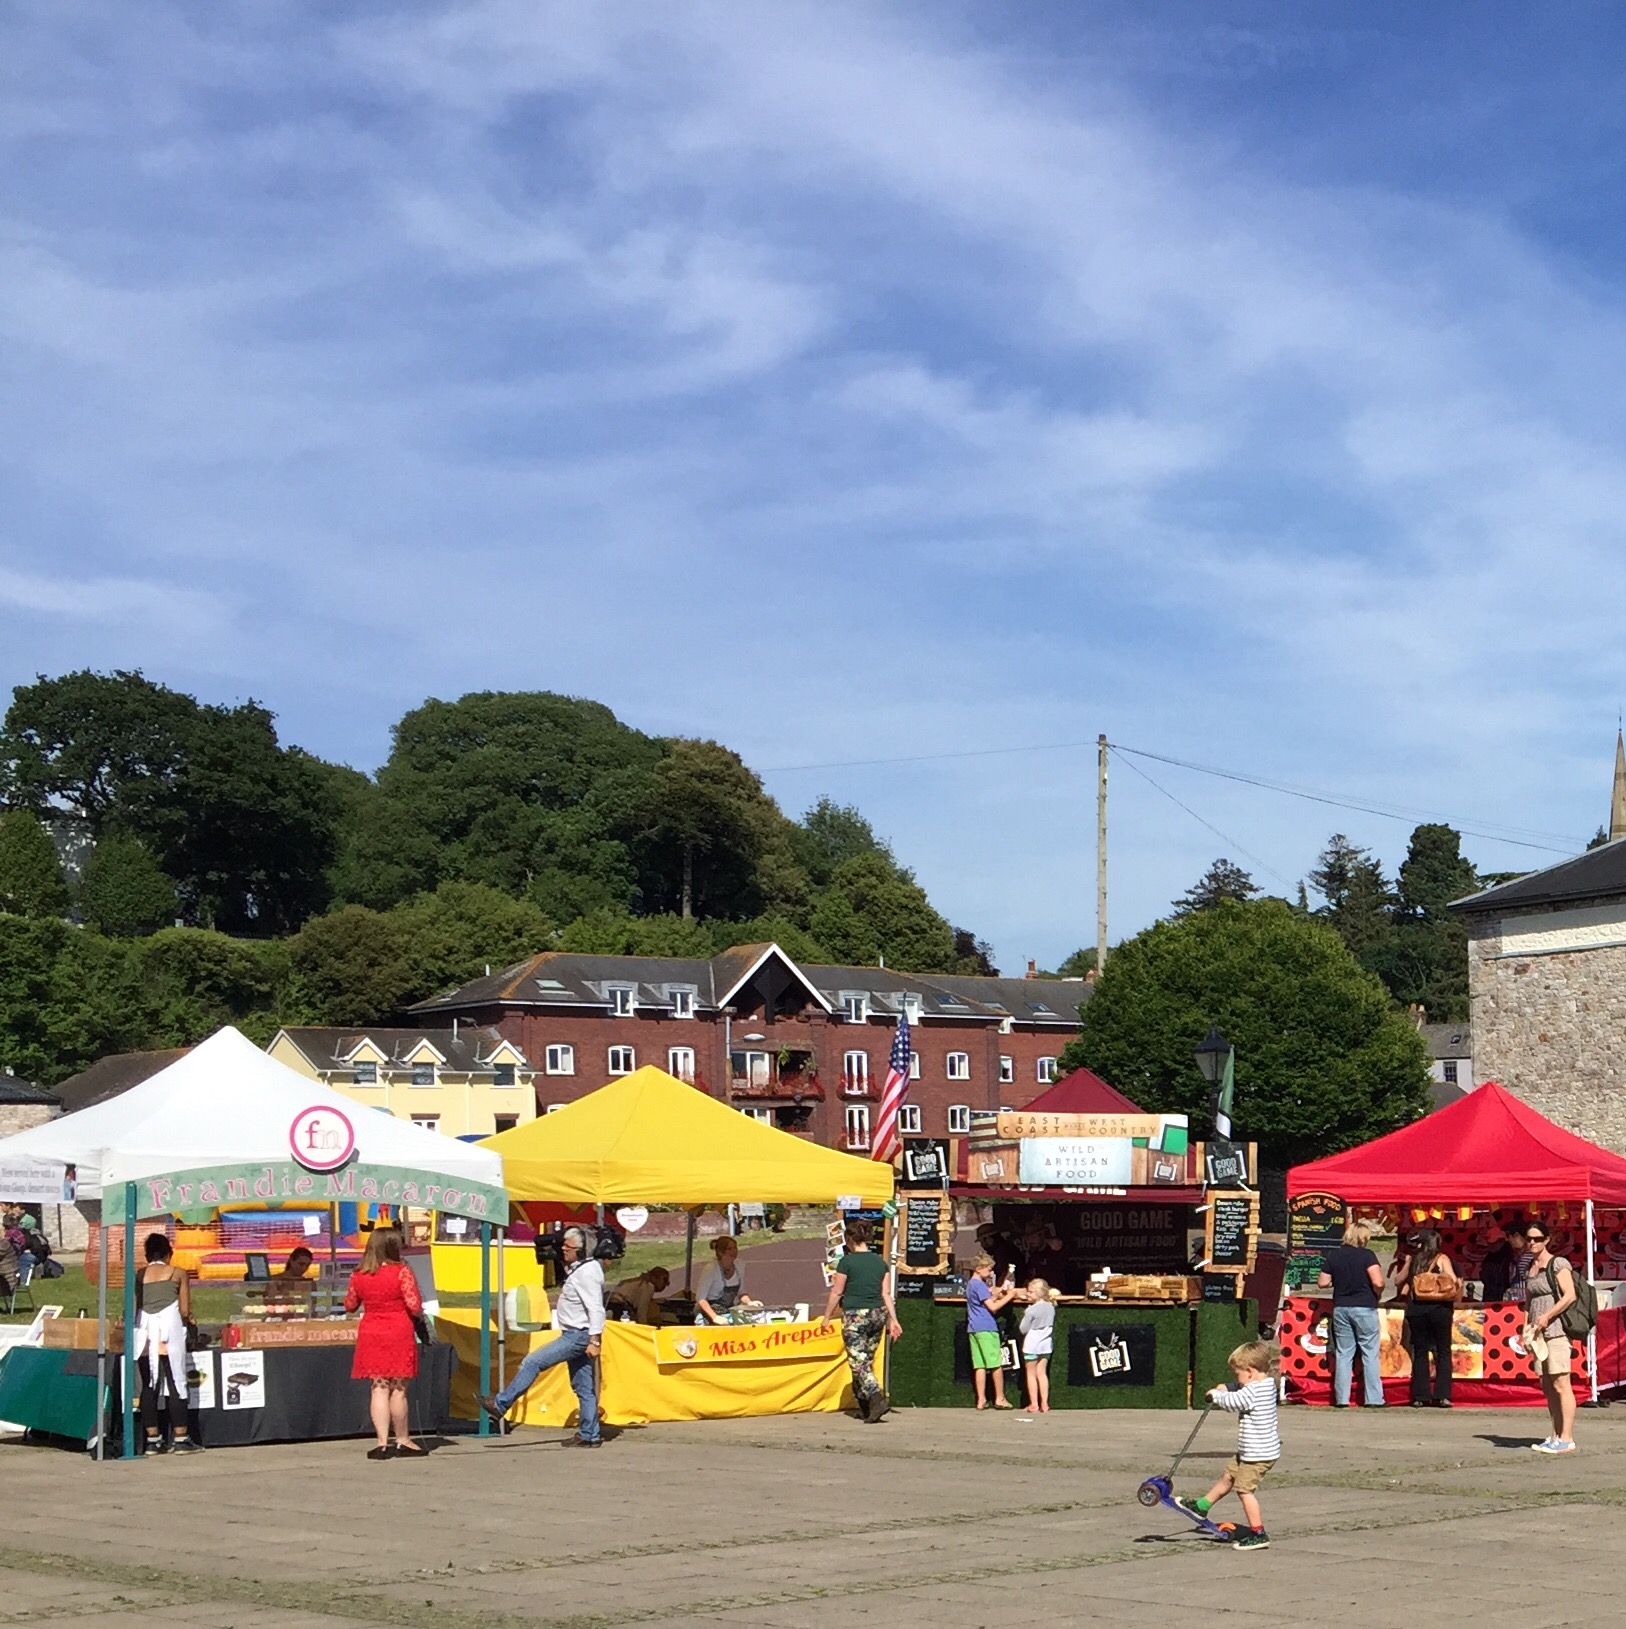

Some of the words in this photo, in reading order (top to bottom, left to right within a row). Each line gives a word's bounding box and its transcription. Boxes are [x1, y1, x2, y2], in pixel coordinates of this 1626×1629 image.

[1018, 1116, 1060, 1125] EAST
[1089, 1118, 1126, 1126] WEST
[1003, 1126, 1060, 1134] COAST
[1089, 1126, 1157, 1135] COUNTRY
[1058, 1145, 1095, 1154] WILD
[914, 1153, 937, 1167] GOOD
[1044, 1158, 1108, 1166] ARTISAN
[1215, 1157, 1237, 1169] GOOD
[915, 1164, 939, 1175] GAME
[1056, 1170, 1097, 1178] FOOD
[1216, 1166, 1238, 1179] GAME
[147, 1167, 314, 1211] Frandie
[326, 1168, 488, 1216] Macaron
[1080, 1211, 1124, 1230] GOOD
[1128, 1210, 1174, 1230] GAME
[307, 1327, 359, 1342] macar
[709, 1337, 757, 1358] Miss
[762, 1321, 836, 1351] Arepas
